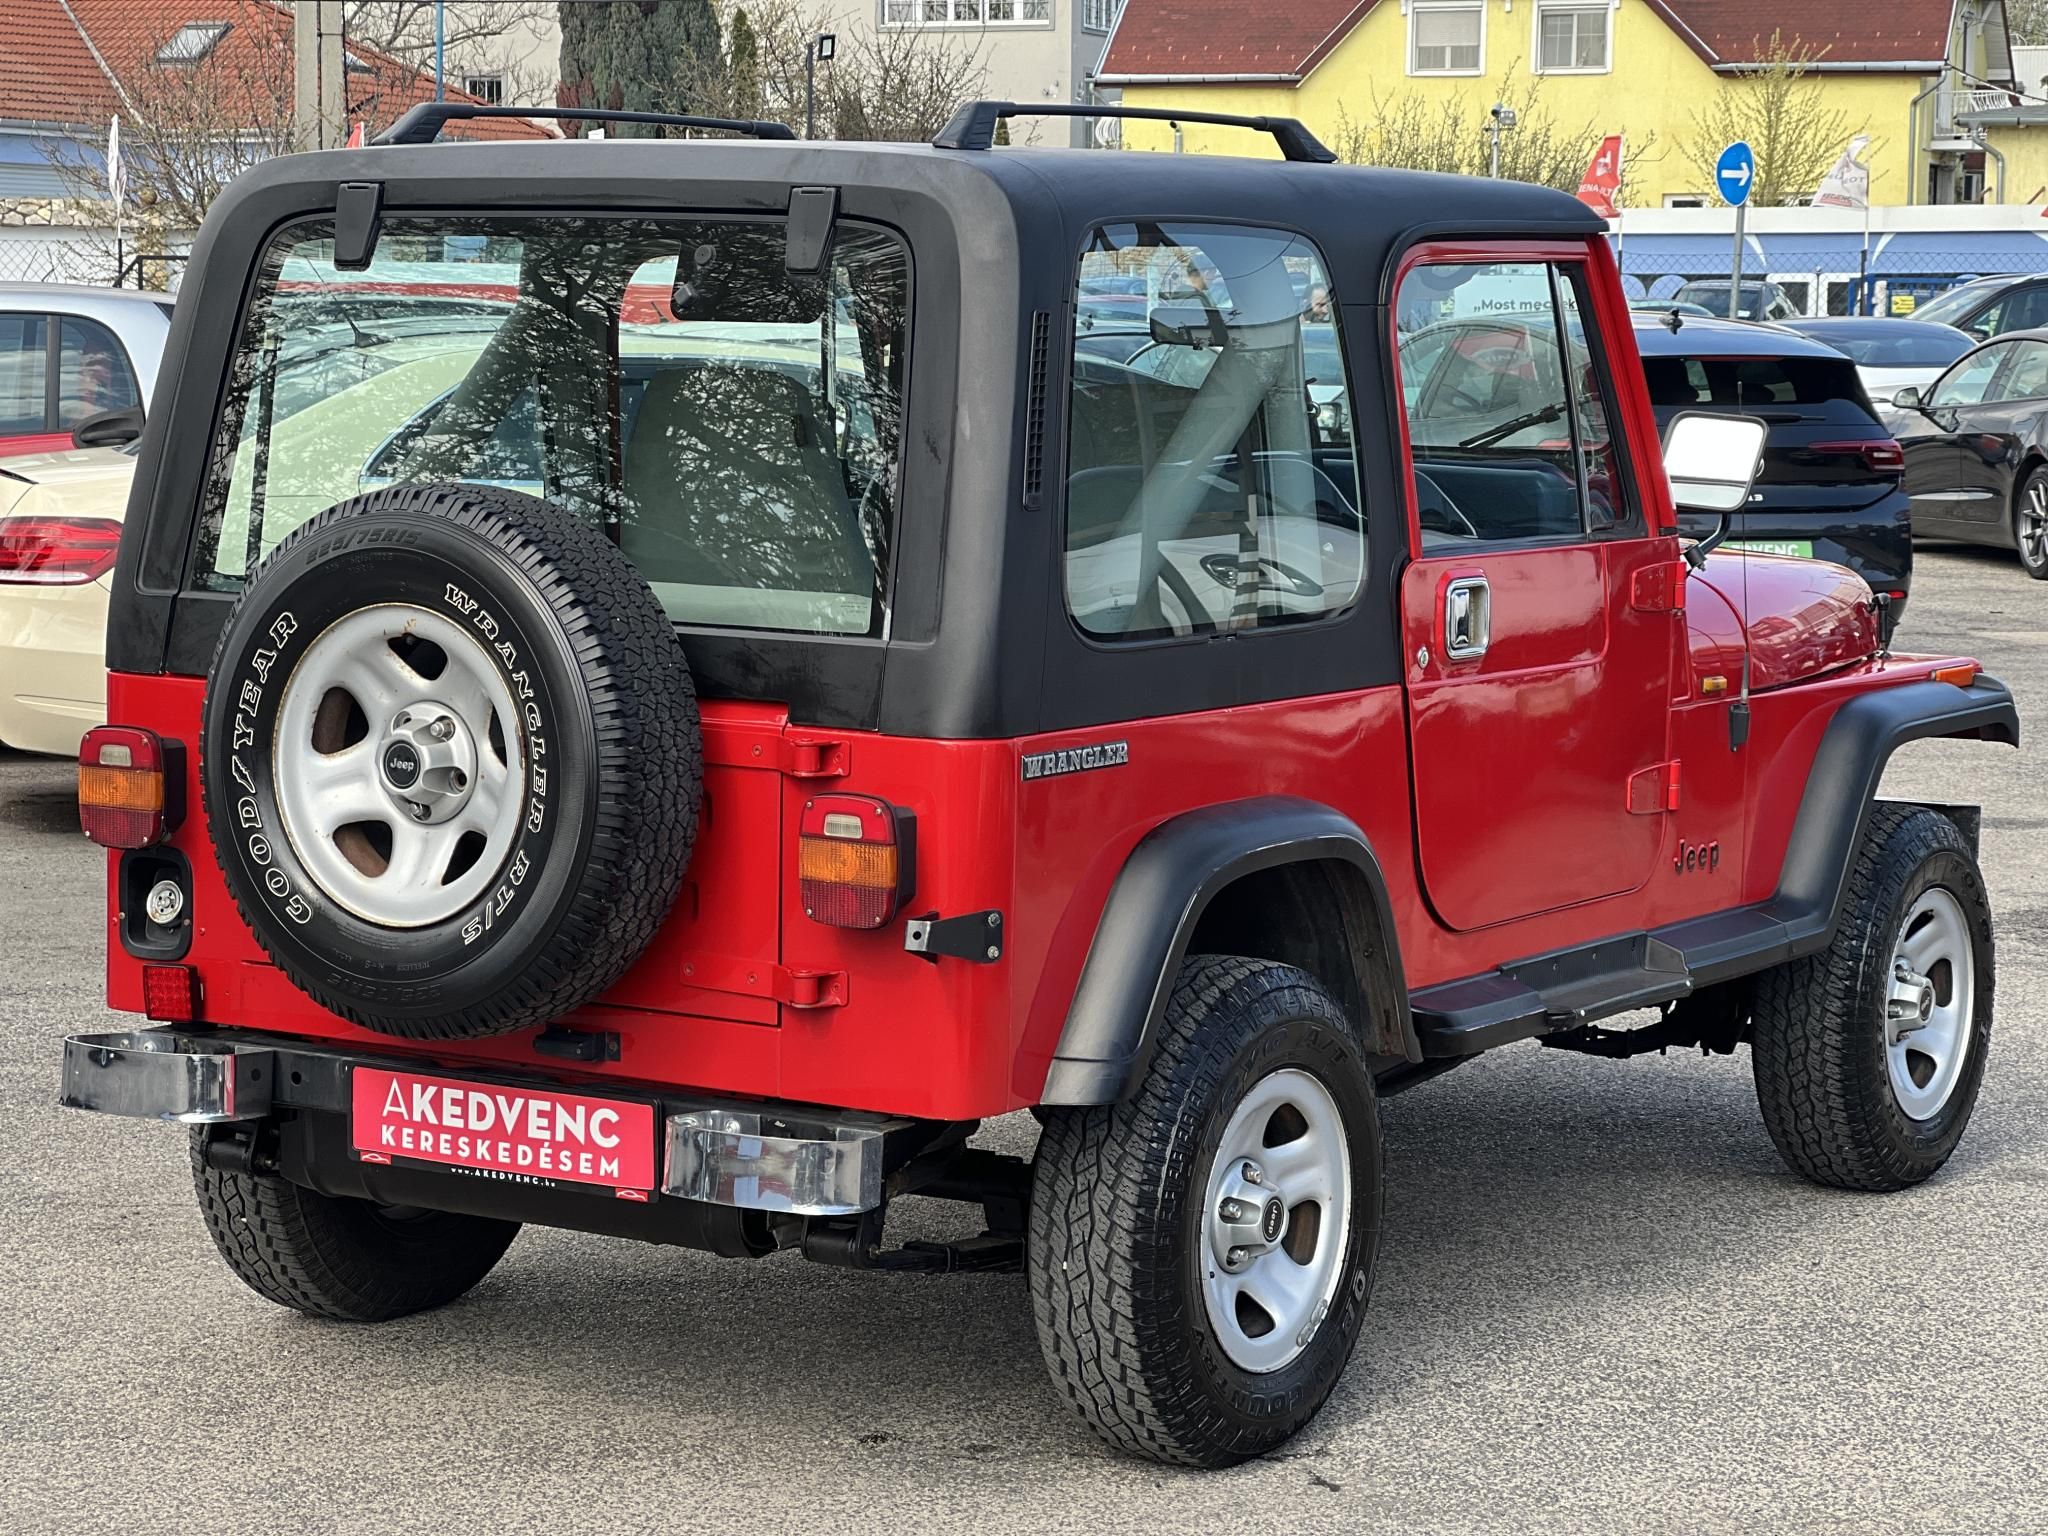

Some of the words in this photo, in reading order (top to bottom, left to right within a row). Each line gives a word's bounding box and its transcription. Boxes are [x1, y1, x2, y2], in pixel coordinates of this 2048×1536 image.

[445, 584, 548, 834] WRANGLER
[390, 757, 415, 772] Jeep
[1024, 741, 1129, 779] WRANGLER
[1673, 839, 1720, 875] Jeep
[461, 850, 530, 946] RT/S
[381, 1124, 620, 1178] KERESKEDÉSEM
[450, 1167, 557, 1188] www.AKEDVENC.hu
[1267, 1204, 1278, 1234] Jeep
